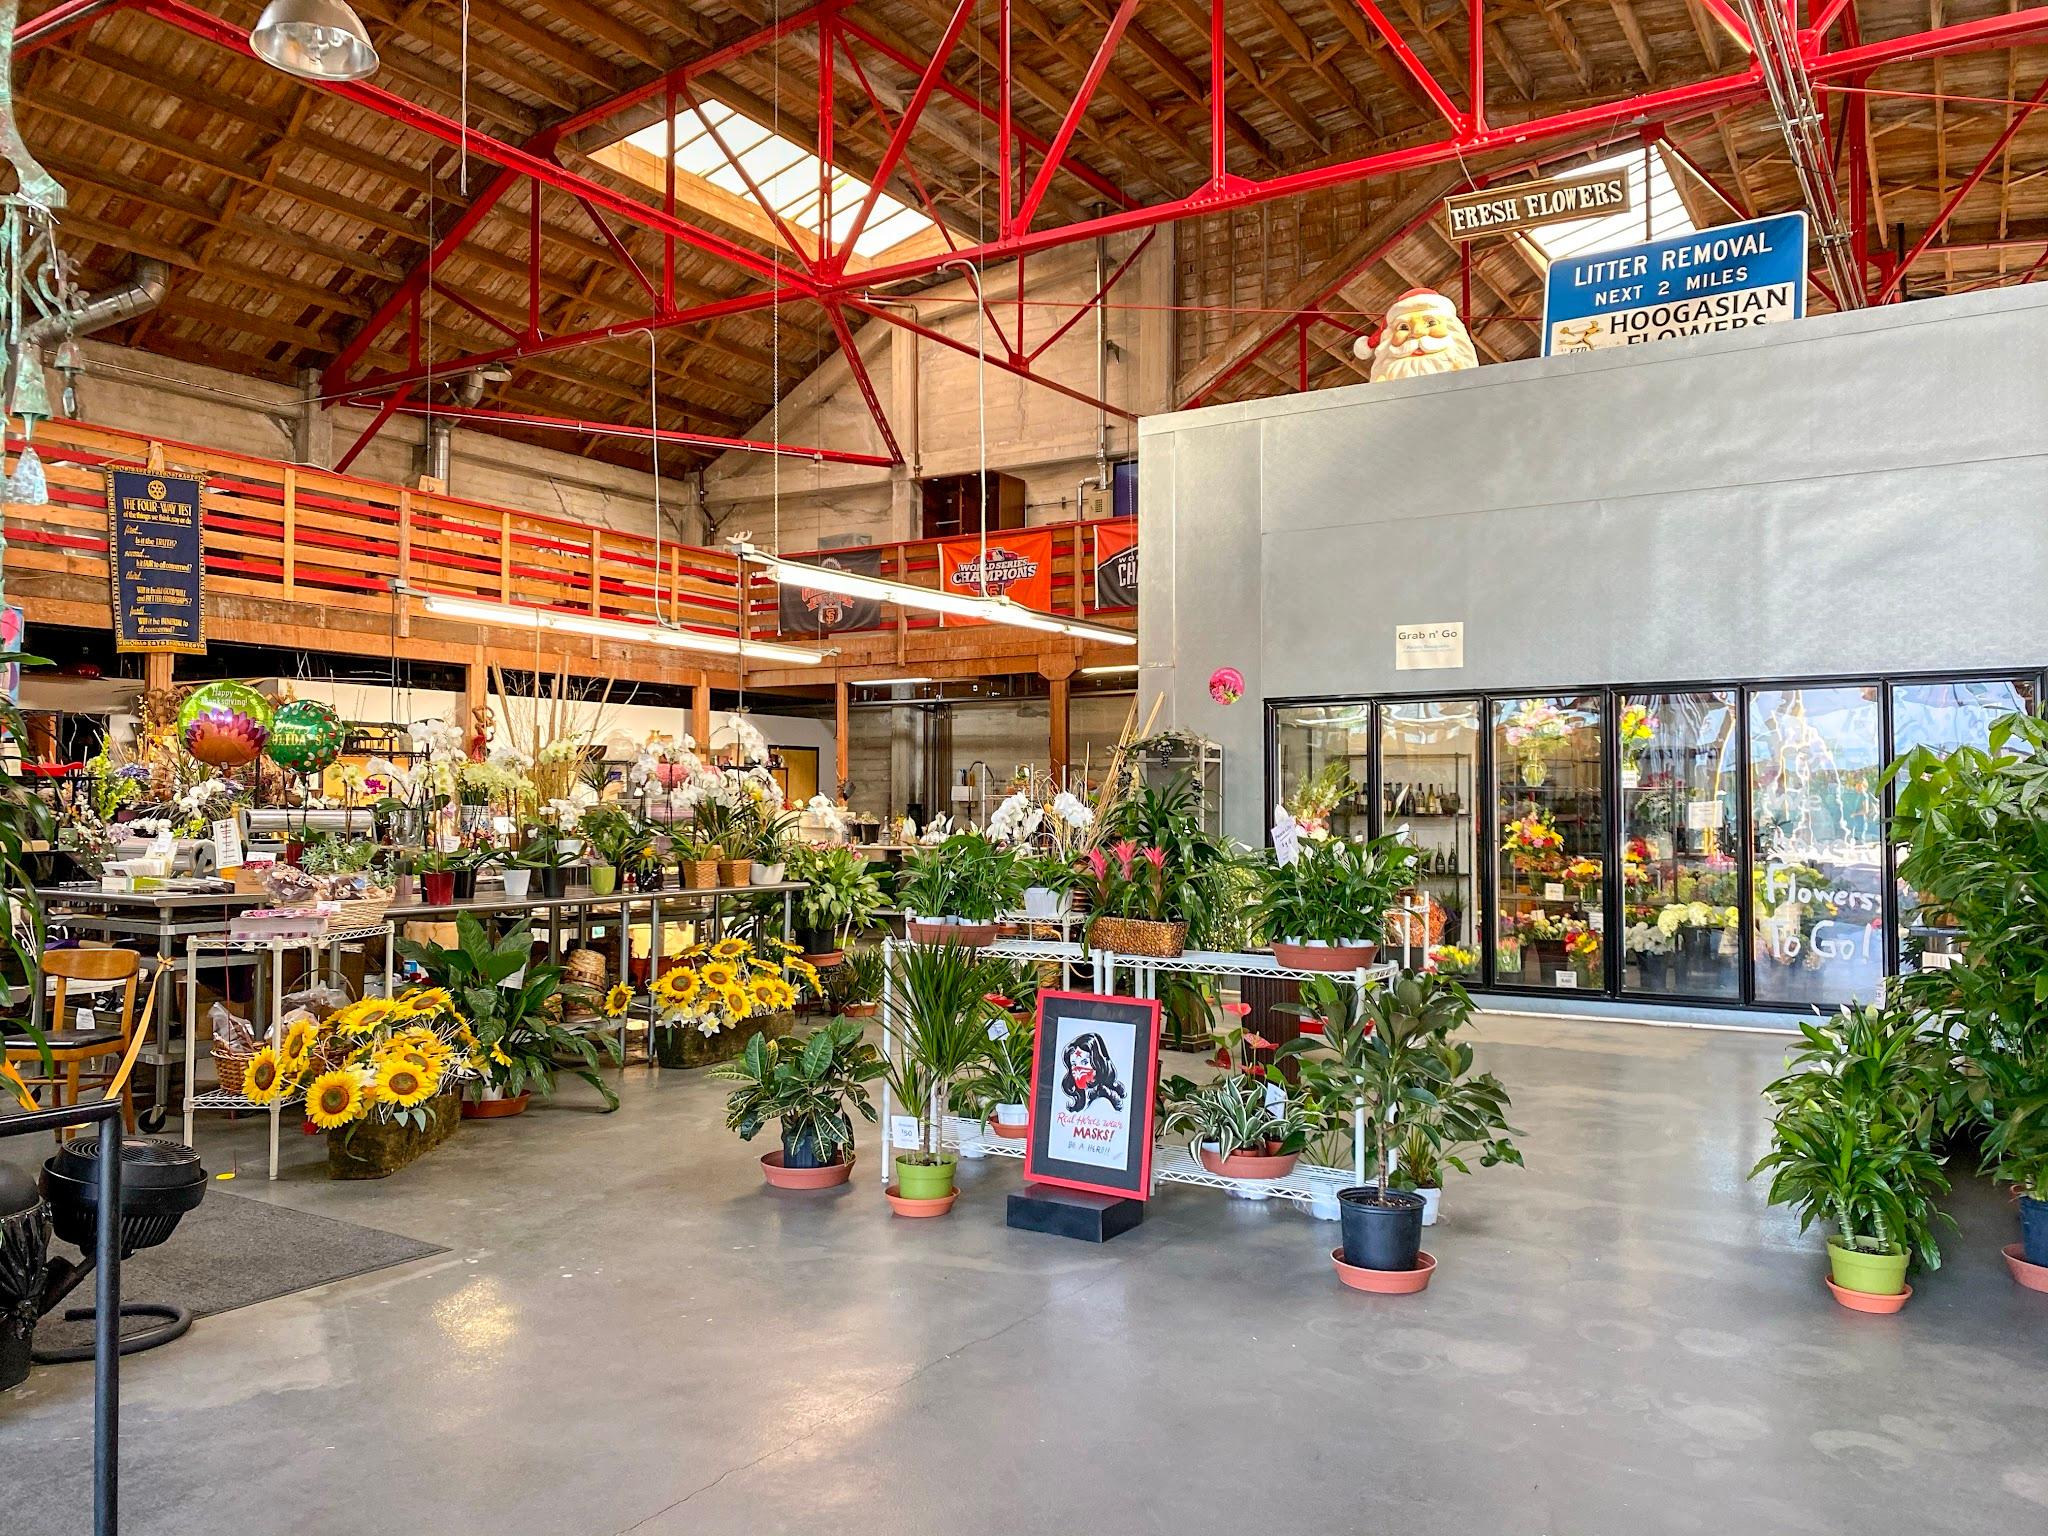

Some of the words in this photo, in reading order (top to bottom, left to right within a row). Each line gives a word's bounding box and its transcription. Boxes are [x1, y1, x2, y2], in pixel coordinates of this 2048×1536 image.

[1451, 198, 1521, 231] FRESH
[1524, 179, 1623, 218] FLOWERS
[1574, 255, 1648, 287] LITTER
[1661, 231, 1773, 271] REMOVAL
[1595, 285, 1644, 306] NEXT
[1657, 280, 1670, 296] 2
[1686, 266, 1748, 291] MILES
[1609, 286, 1788, 335] HOOGASIAN
[952, 565, 1037, 584] CHAMPIONS
[995, 559, 1028, 569] SERIES
[1398, 631, 1426, 640] Grab
[1441, 629, 1458, 638] Go
[1766, 863, 1875, 912] Flowers
[1766, 919, 1802, 958] To
[1073, 1126, 1116, 1143] MASKS!
